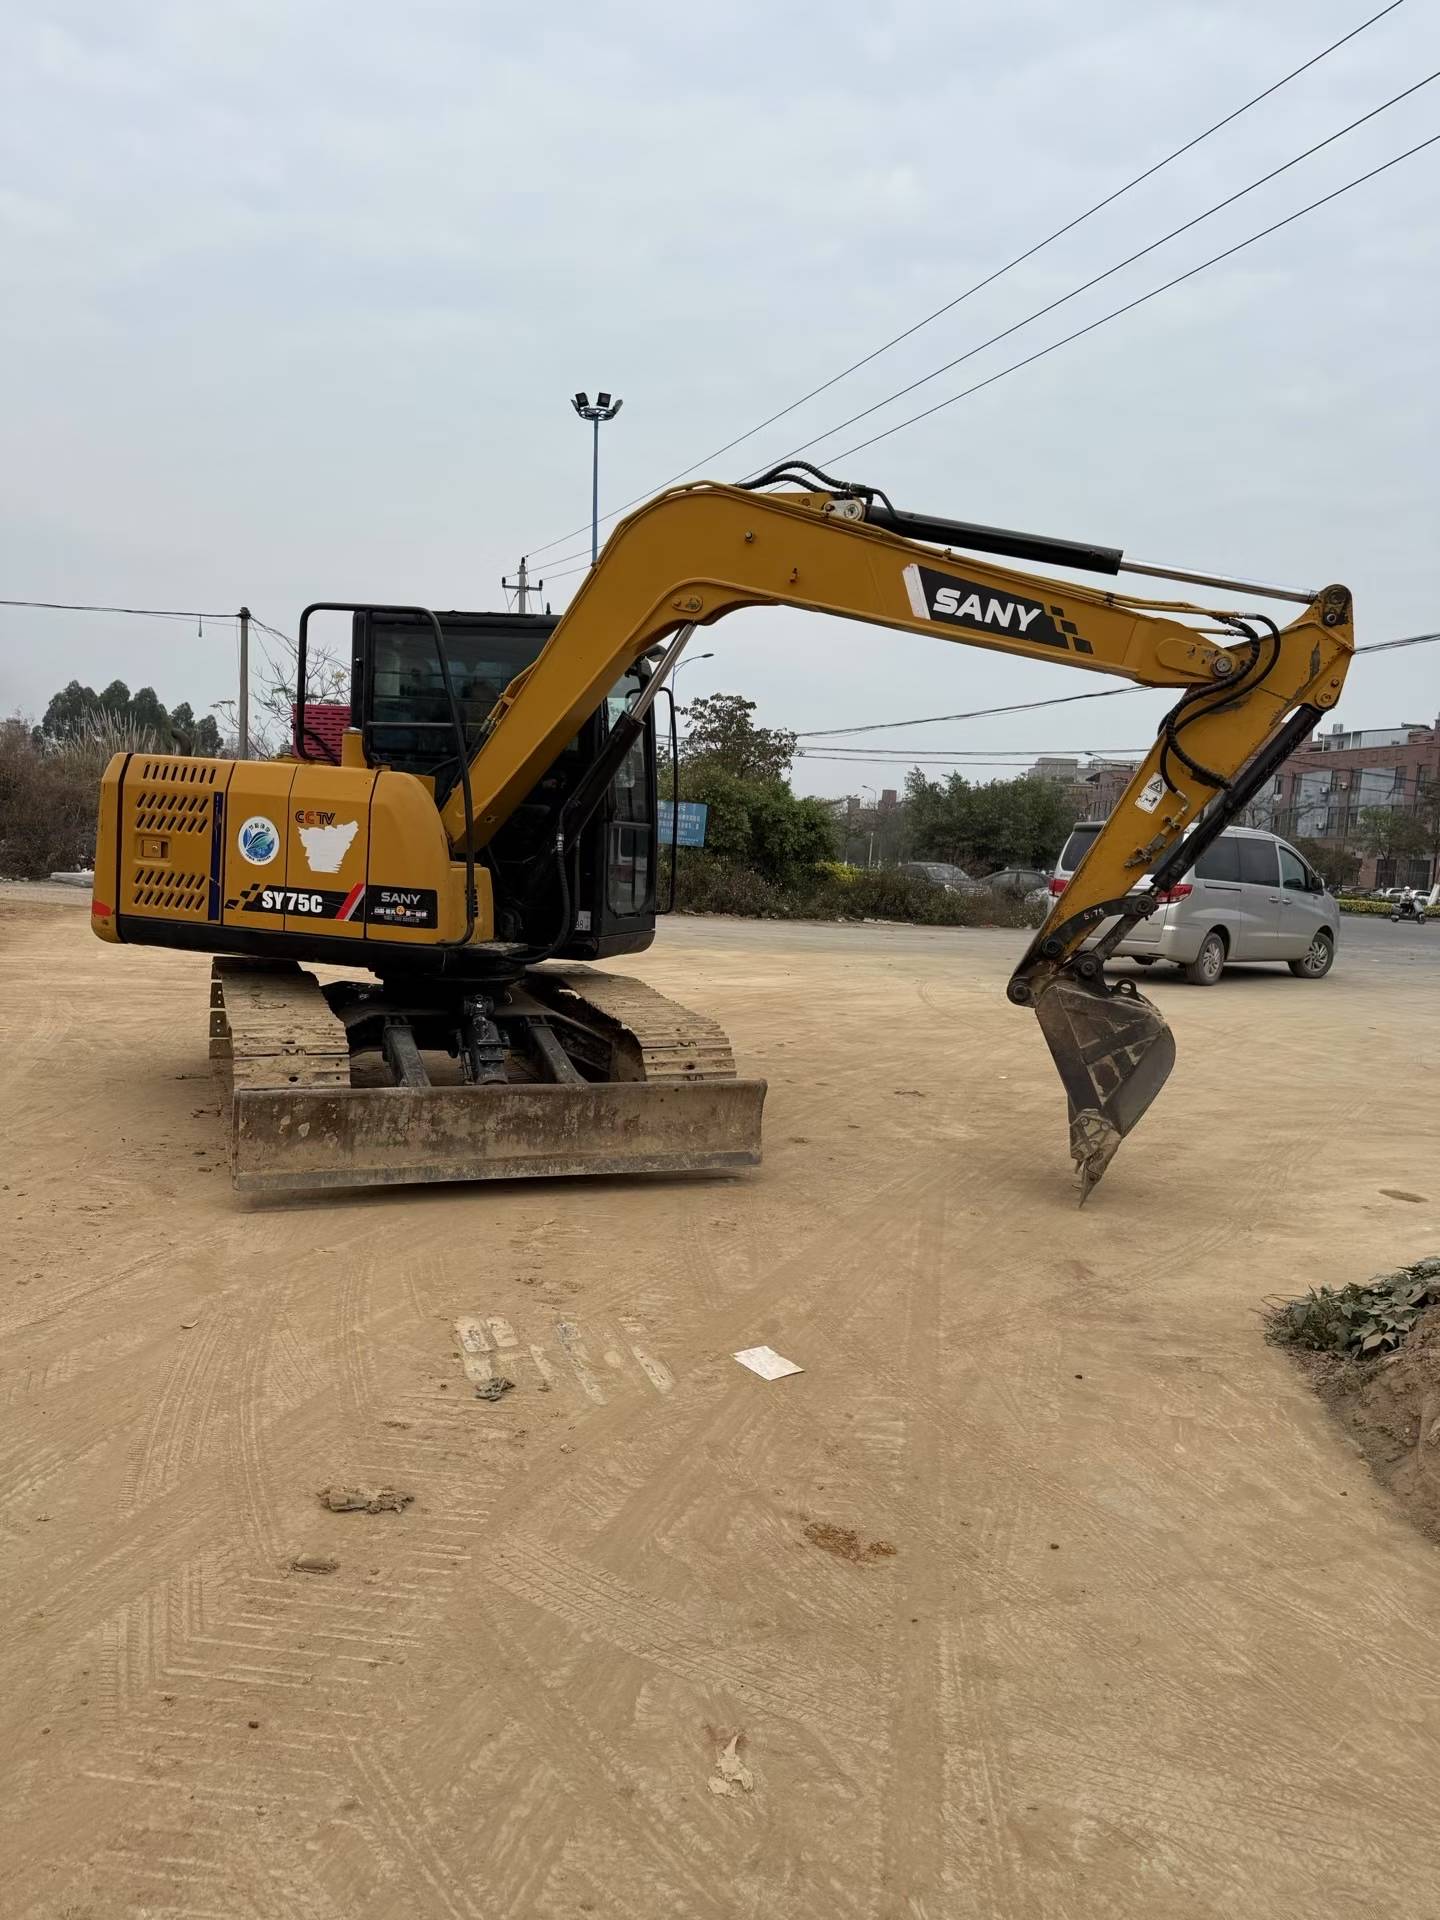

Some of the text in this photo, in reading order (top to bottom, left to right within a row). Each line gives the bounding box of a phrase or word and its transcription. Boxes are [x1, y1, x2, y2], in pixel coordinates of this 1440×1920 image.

[933, 587, 1042, 632] SANY
[295, 810, 336, 825] CCTV
[261, 890, 323, 913] SY75C
[381, 892, 421, 905] SANY
